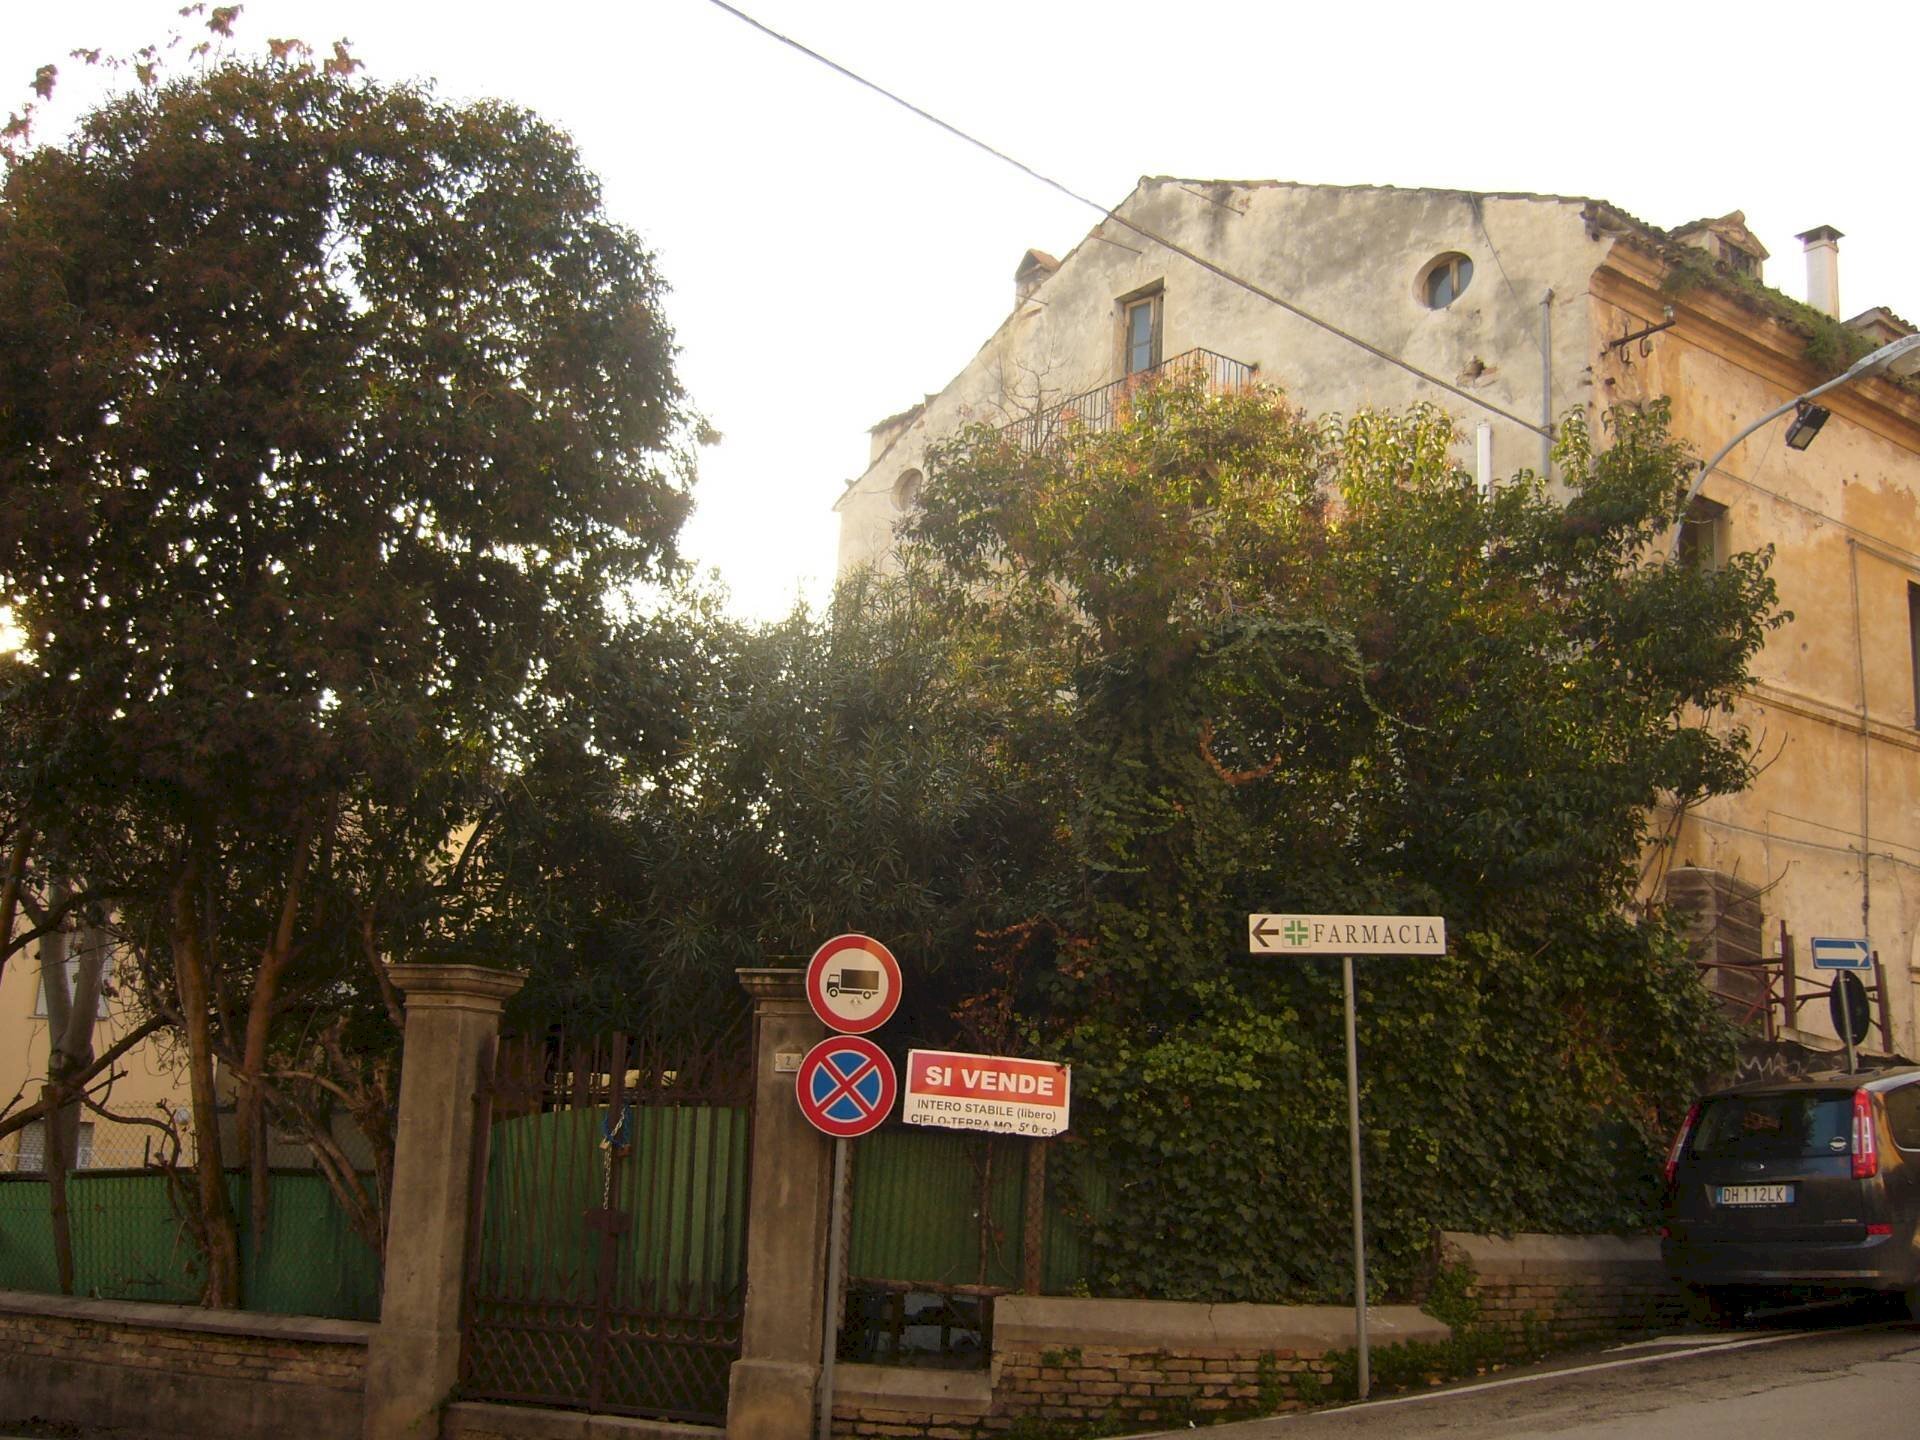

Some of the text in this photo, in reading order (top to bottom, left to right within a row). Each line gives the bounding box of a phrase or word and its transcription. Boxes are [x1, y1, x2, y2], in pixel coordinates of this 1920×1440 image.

[1313, 923, 1439, 945] FARMACIA
[925, 1065, 1054, 1097] SI VENDE
[917, 1099, 1057, 1122] INTERO STABILE (libero)
